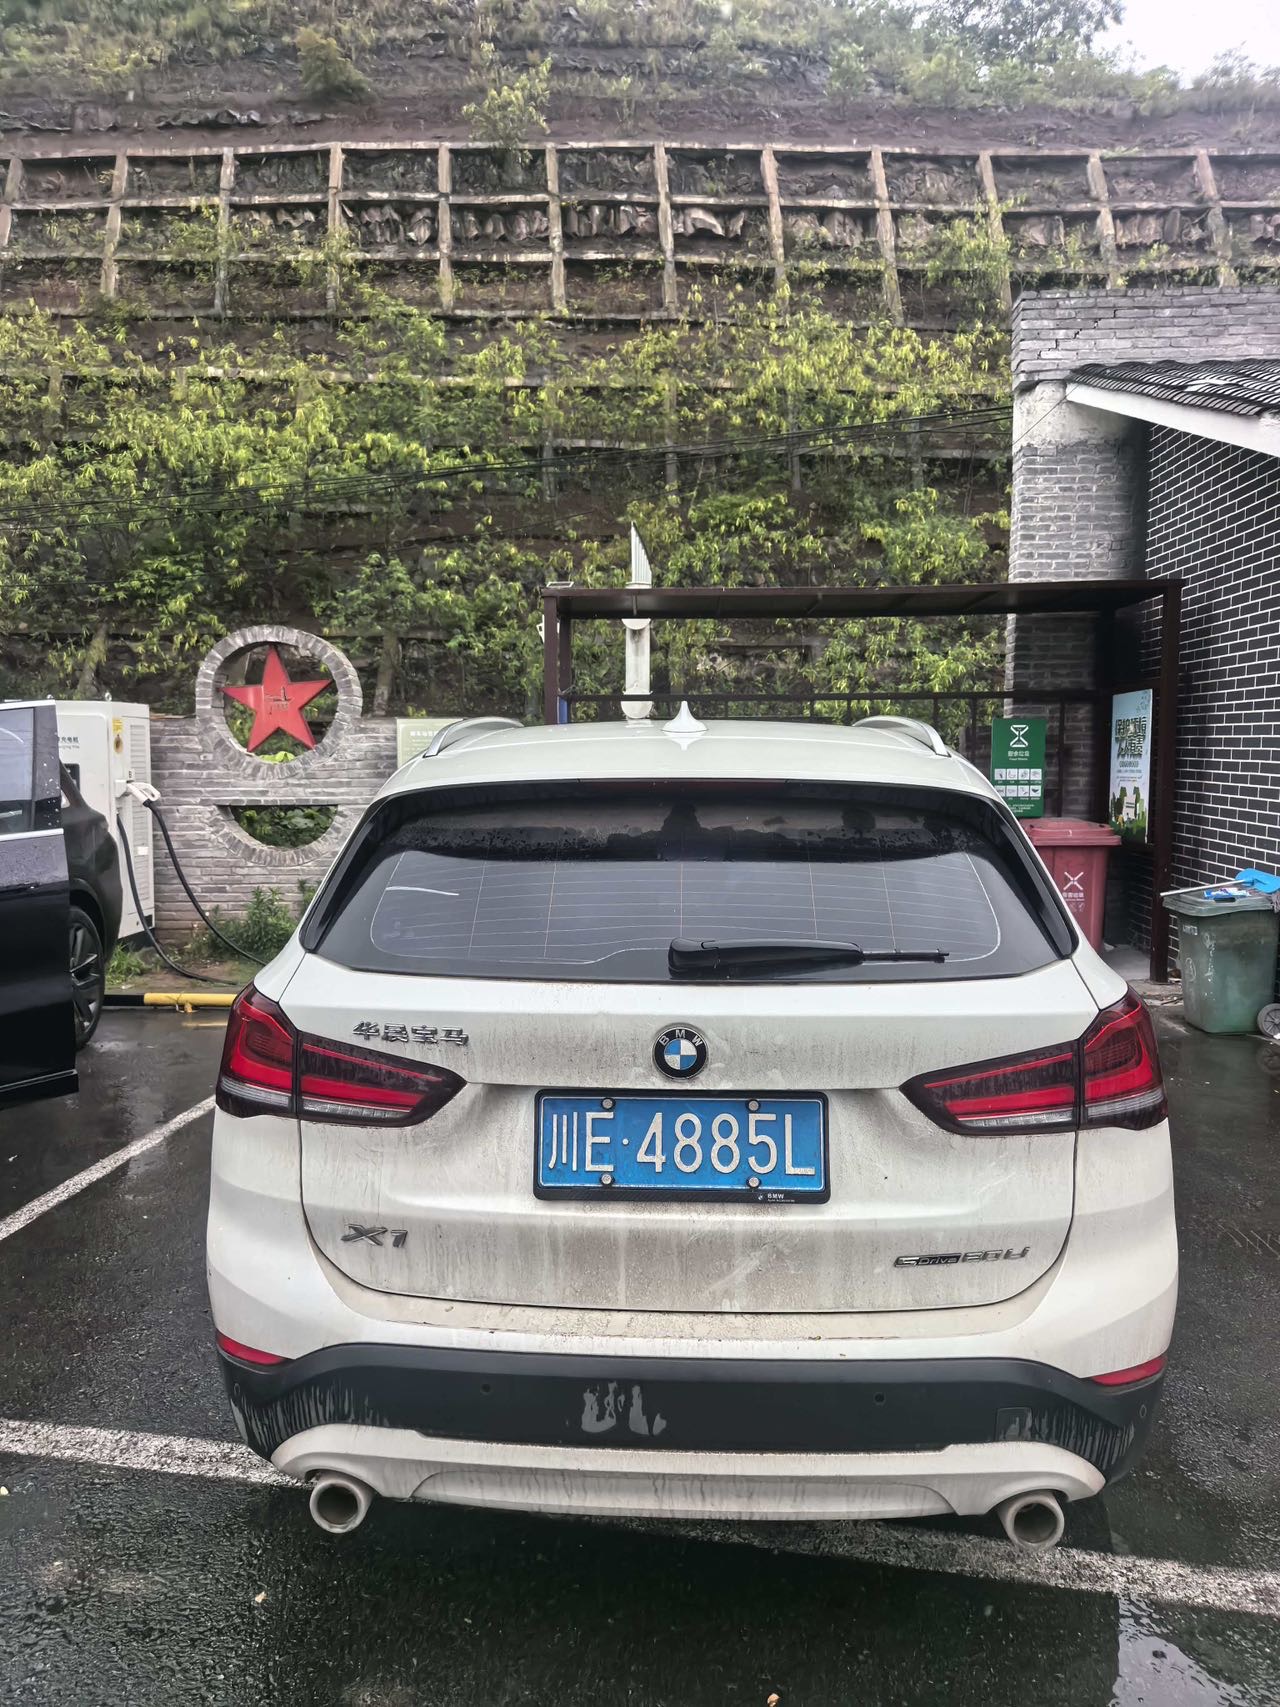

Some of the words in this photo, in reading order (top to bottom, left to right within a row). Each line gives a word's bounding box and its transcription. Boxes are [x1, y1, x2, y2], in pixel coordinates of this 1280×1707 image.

[352, 1021, 469, 1046] 华晨宝马
[659, 1029, 703, 1046] BMW
[548, 1111, 816, 1175] 川E·4885L
[340, 1224, 408, 1248] X1
